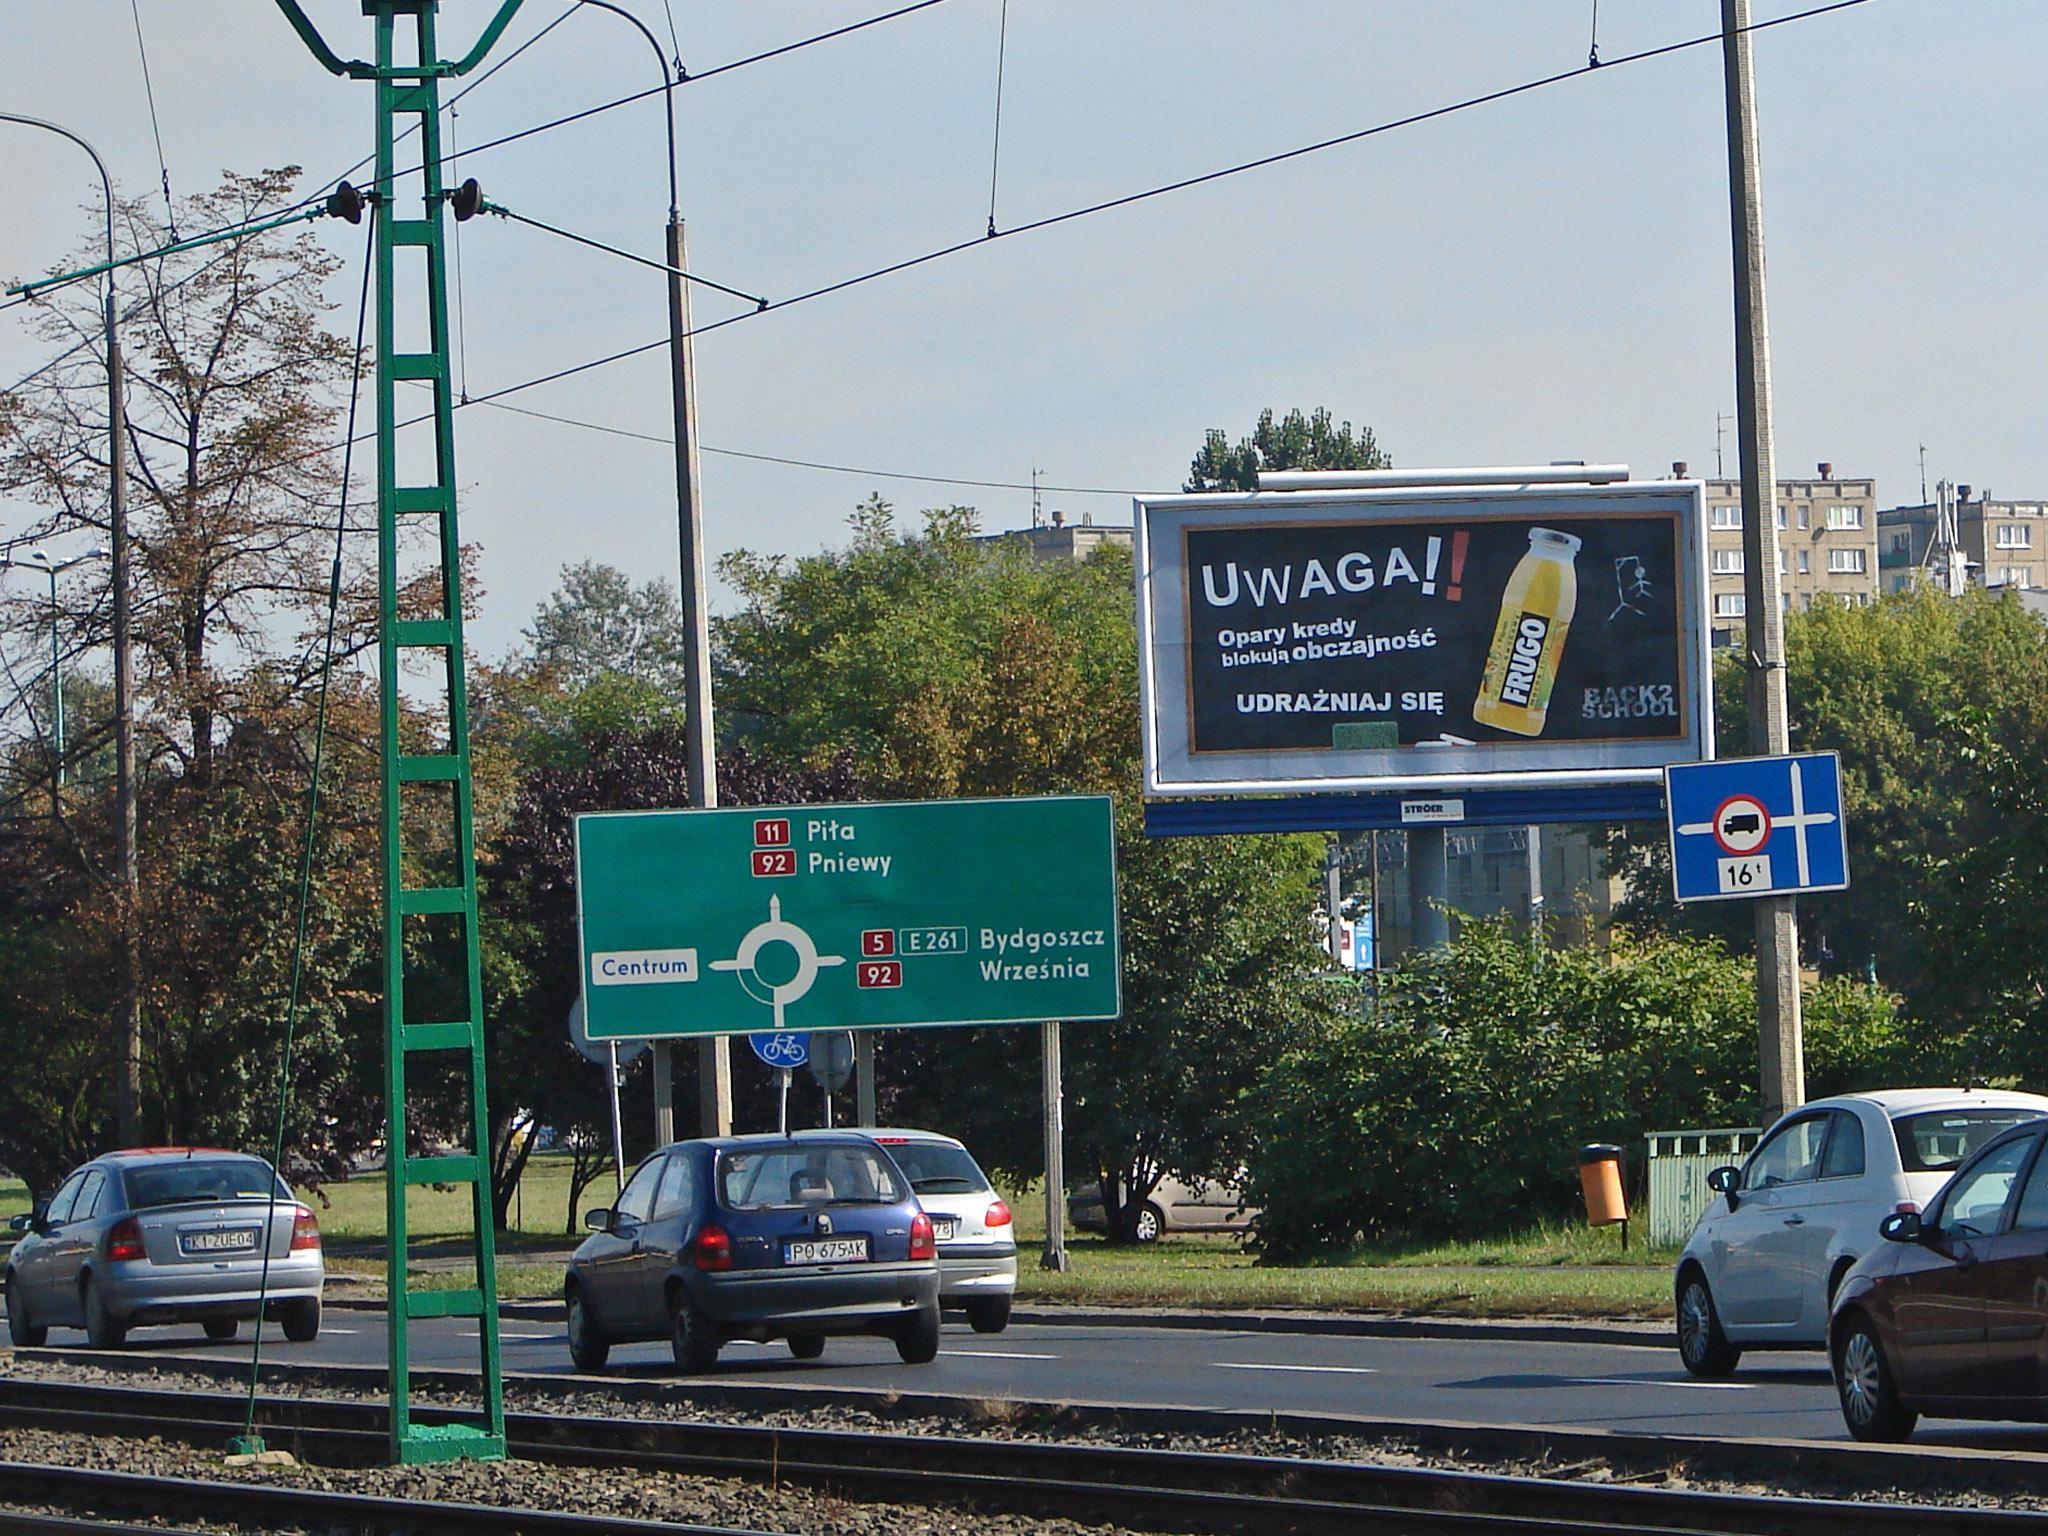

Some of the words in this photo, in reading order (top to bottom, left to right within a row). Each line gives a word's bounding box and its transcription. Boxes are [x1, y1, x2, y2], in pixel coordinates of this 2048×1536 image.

[1218, 627, 1286, 648] Opary
[1292, 617, 1357, 640] kredy
[1221, 648, 1290, 668] blokują
[1292, 627, 1438, 661] obczajność
[1501, 618, 1547, 705] FRUGO
[1236, 689, 1392, 713] UDRAŻNIAJ
[1401, 692, 1444, 715] SIĘ
[1583, 684, 1673, 705] BACK2
[1582, 700, 1678, 719] SCHOOL
[764, 823, 779, 842] 11
[807, 819, 855, 842] Piła
[762, 854, 786, 873] 92
[809, 852, 892, 878] Pniewy
[1727, 863, 1753, 887] 16
[873, 934, 884, 952] 5
[910, 933, 920, 950] E
[926, 931, 958, 949] 261
[980, 927, 1105, 955] Bydgoszcz
[602, 959, 688, 976] Centrum
[867, 966, 892, 985] 92
[979, 956, 1090, 982] Września
